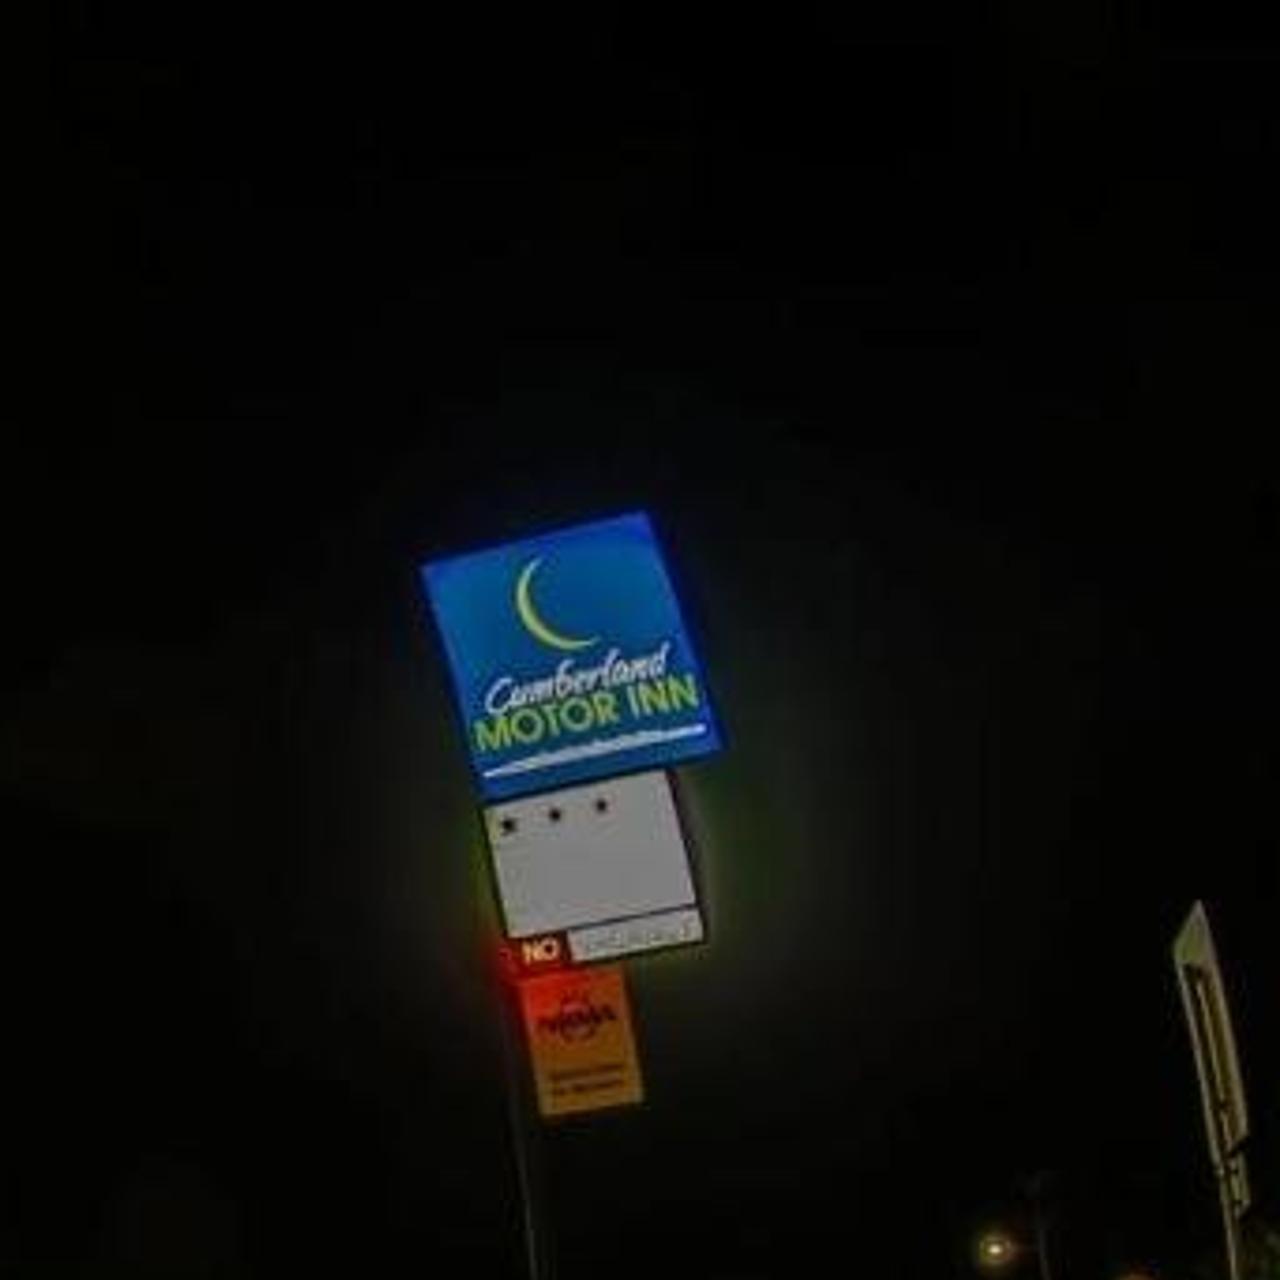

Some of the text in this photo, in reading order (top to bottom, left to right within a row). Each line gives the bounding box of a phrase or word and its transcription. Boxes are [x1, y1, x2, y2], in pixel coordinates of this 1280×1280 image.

[473, 673, 699, 750] MOTOR INN
[485, 640, 671, 714] Cumberland
[520, 936, 562, 965] NO
